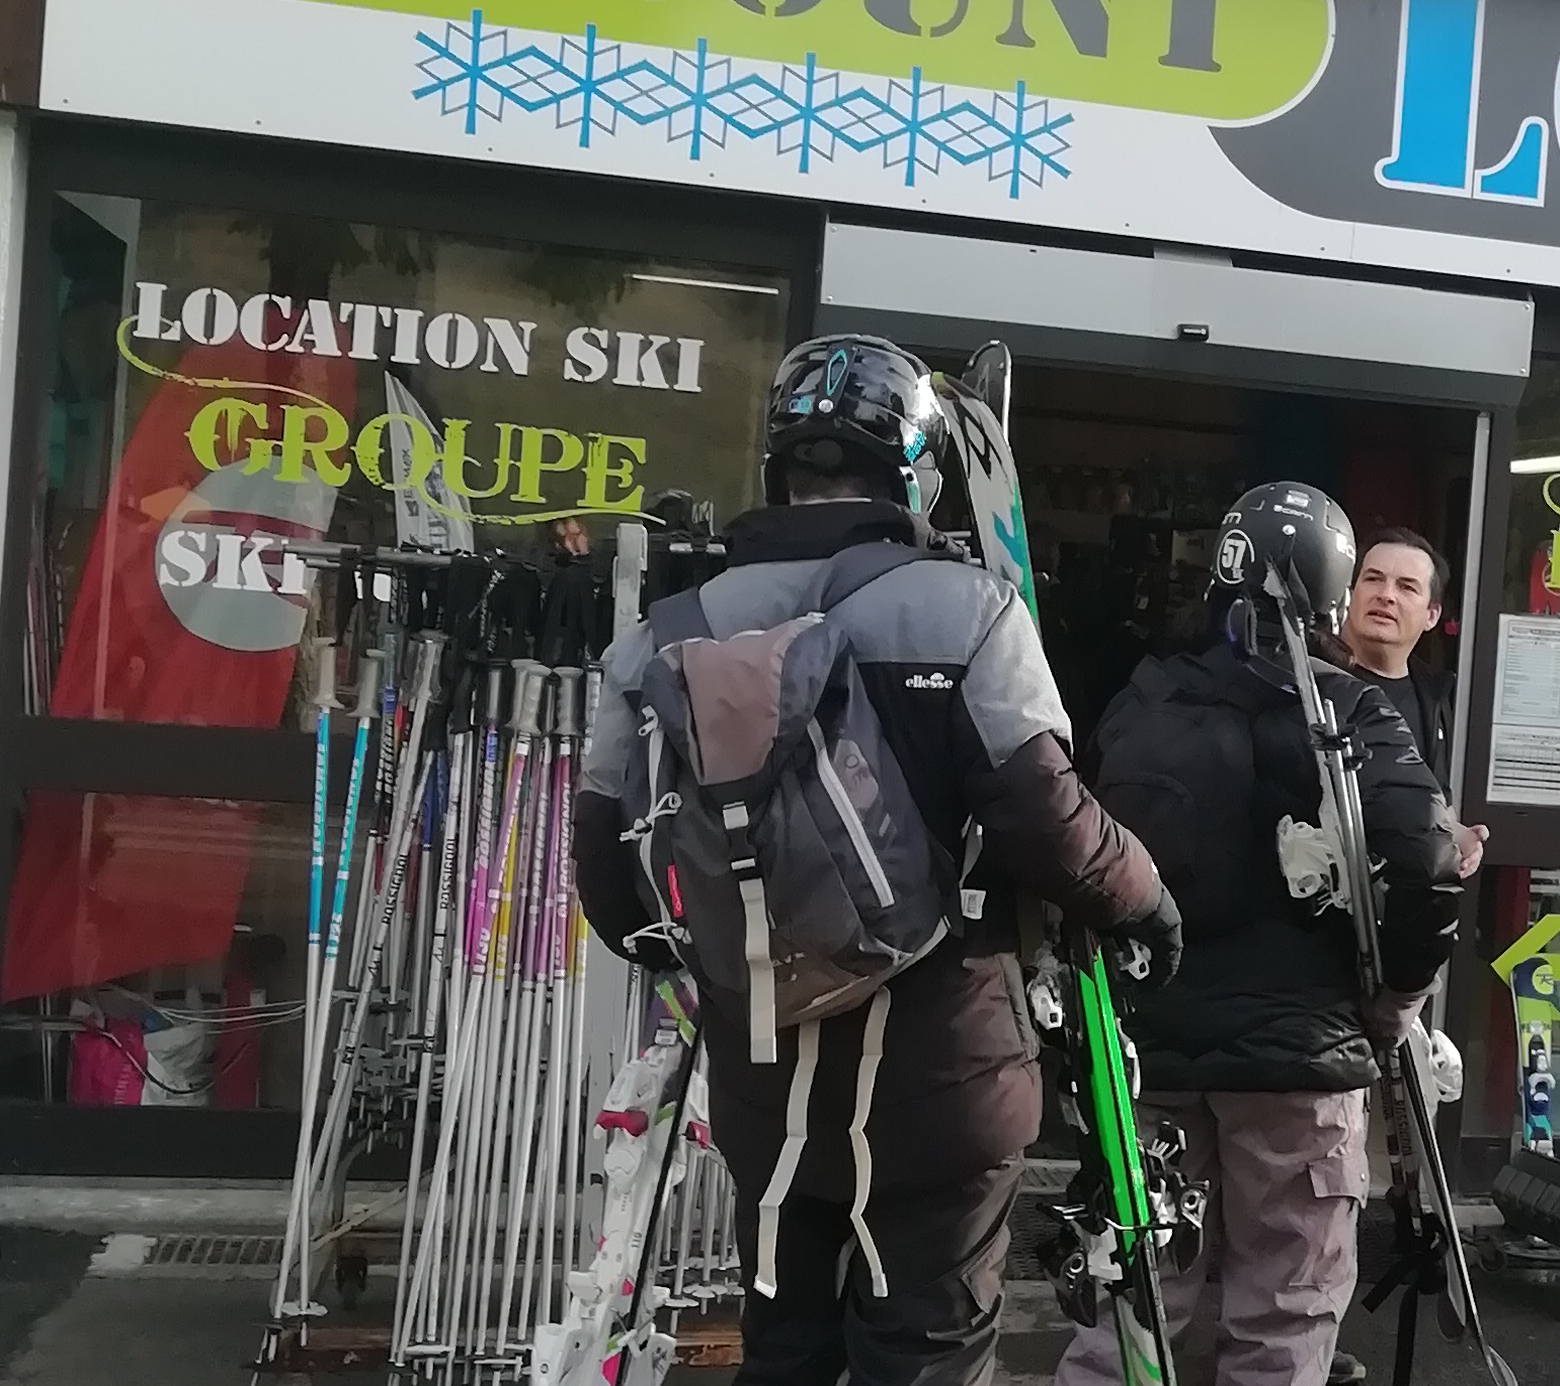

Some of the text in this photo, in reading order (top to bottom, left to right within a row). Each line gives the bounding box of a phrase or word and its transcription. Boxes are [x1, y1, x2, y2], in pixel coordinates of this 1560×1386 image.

[133, 282, 704, 393] LOCATION SKI
[185, 397, 646, 512] GROUPE
[905, 673, 954, 689] ellesse
